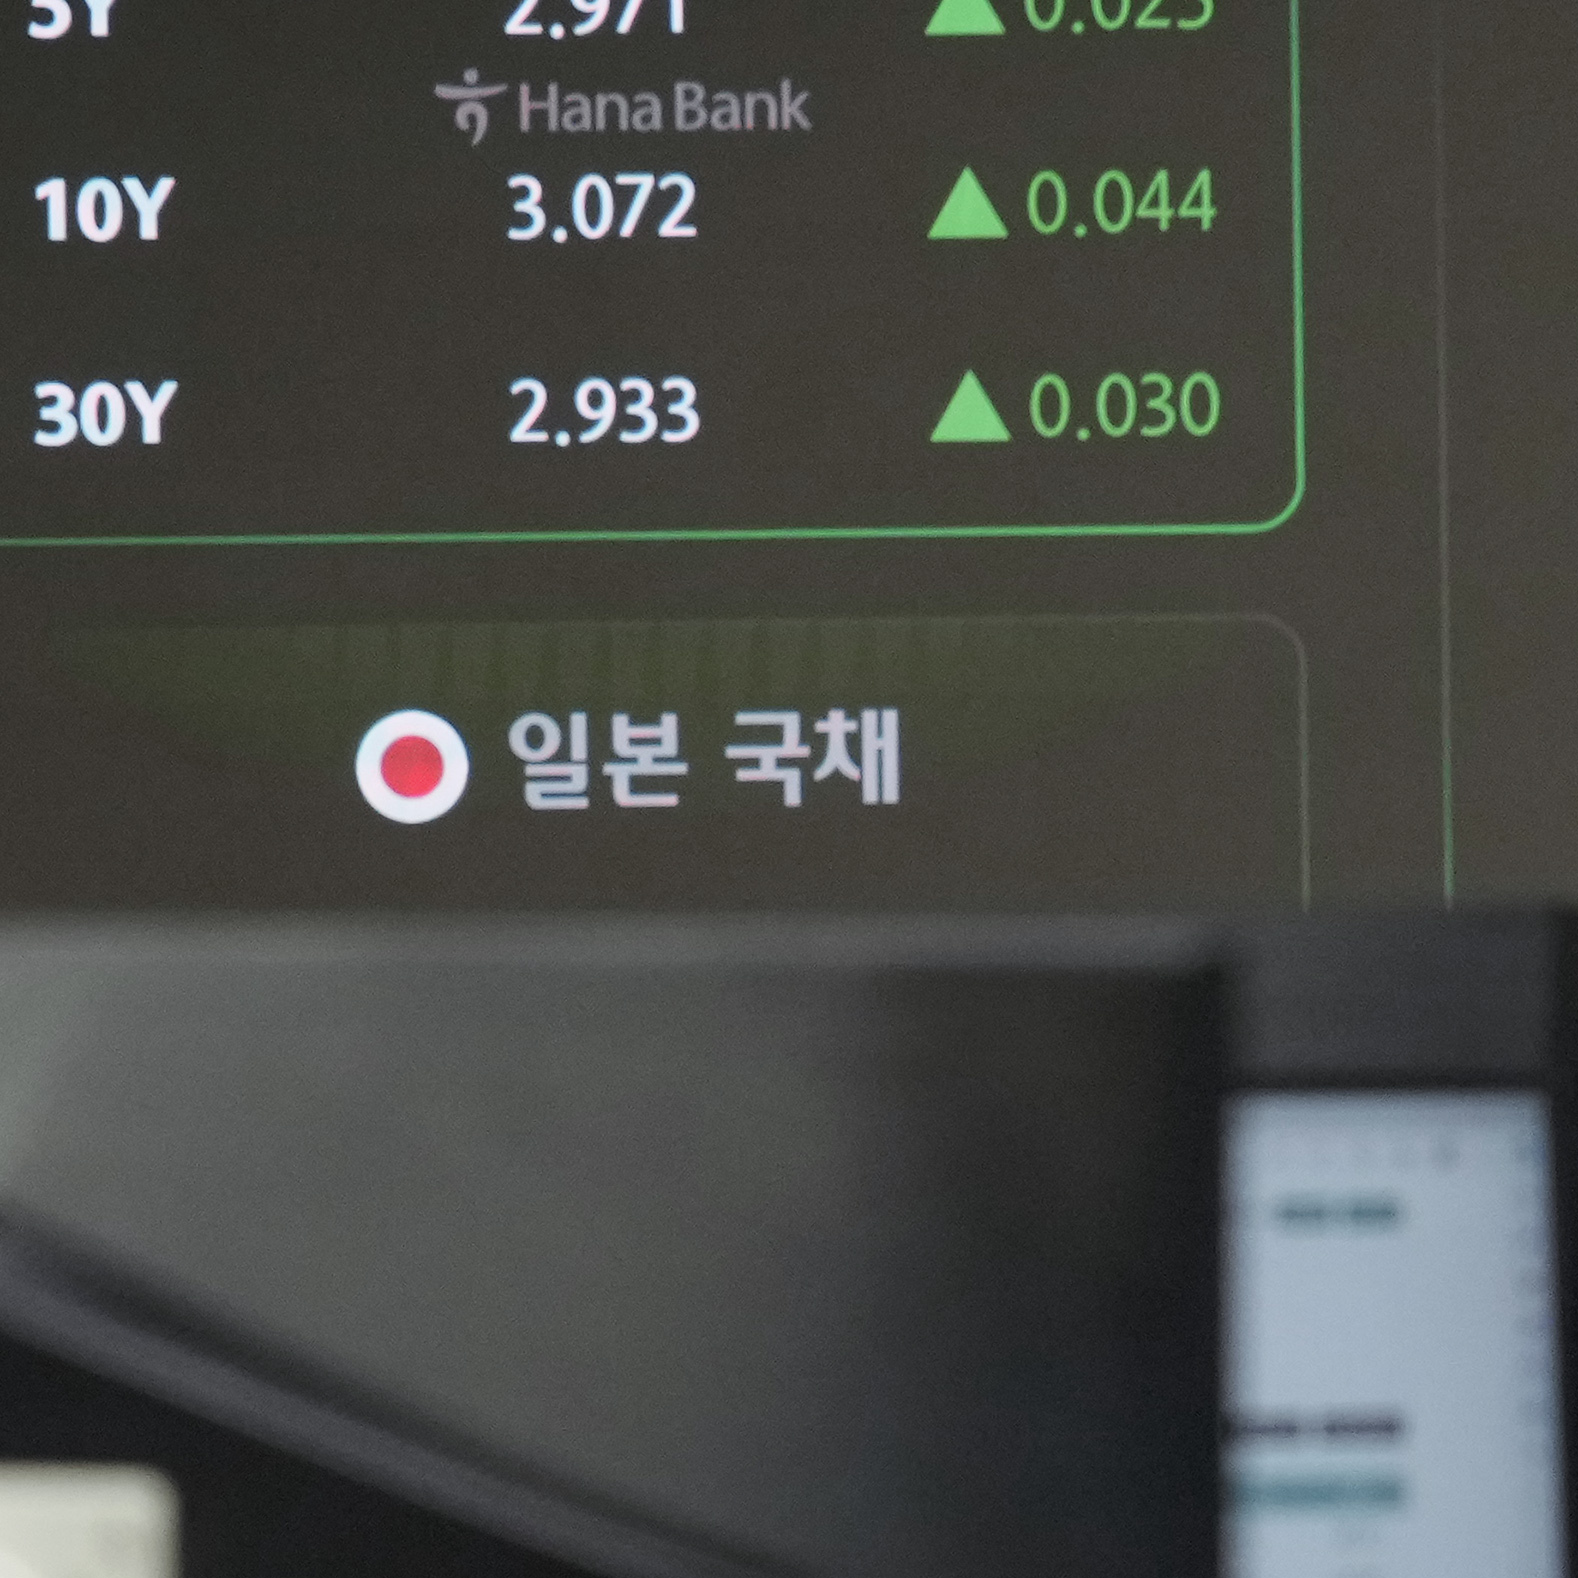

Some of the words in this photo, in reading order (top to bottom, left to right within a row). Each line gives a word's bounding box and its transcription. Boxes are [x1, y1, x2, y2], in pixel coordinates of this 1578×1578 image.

[518, 82, 663, 132] Hana
[674, 79, 812, 131] Bank
[34, 175, 176, 243] 10Y
[506, 171, 697, 244] 3.072
[1026, 168, 1218, 238] 0.044
[33, 378, 178, 447] 30Y
[508, 374, 700, 447] 2.933
[1029, 370, 1221, 441] 0.030
[508, 710, 690, 811] 일본
[724, 707, 901, 808] 국채
